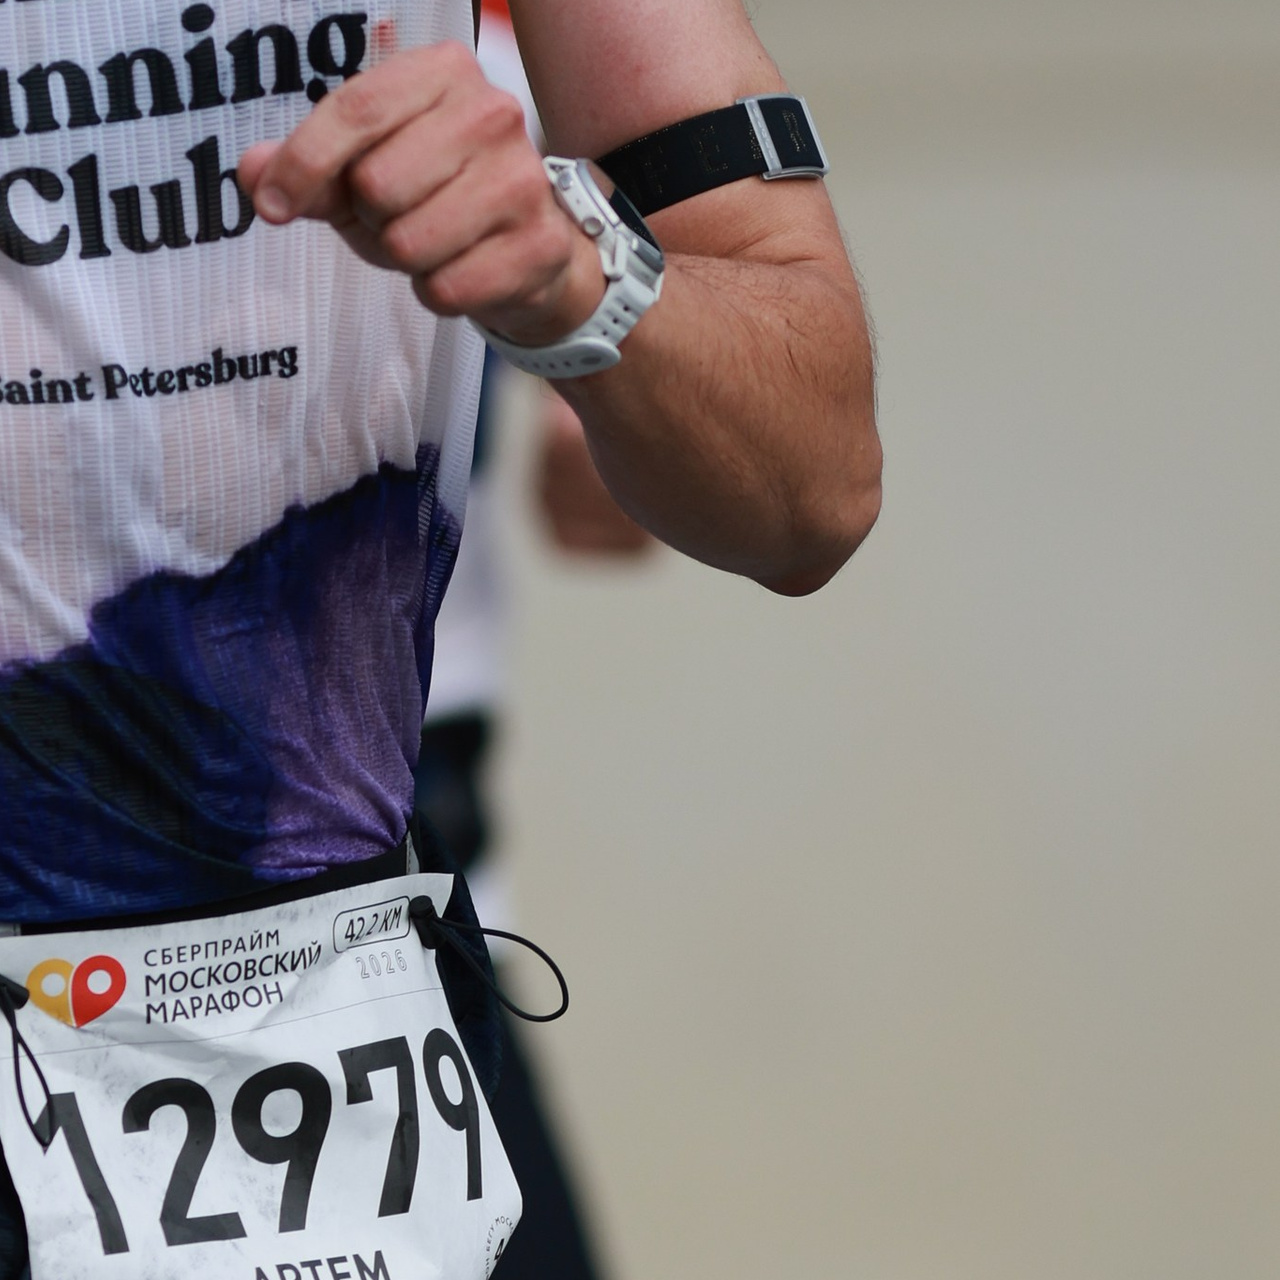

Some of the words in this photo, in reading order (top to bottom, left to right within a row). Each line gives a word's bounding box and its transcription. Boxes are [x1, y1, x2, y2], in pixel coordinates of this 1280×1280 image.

[100, 345, 299, 401] Petersburg
[144, 928, 280, 967] СБЕРПРАЙМ
[145, 939, 322, 997] МОСКОВСКИЙ
[355, 948, 408, 980] 2026
[145, 981, 284, 1025] МАРАФОН
[32, 1027, 483, 1256] 12979
